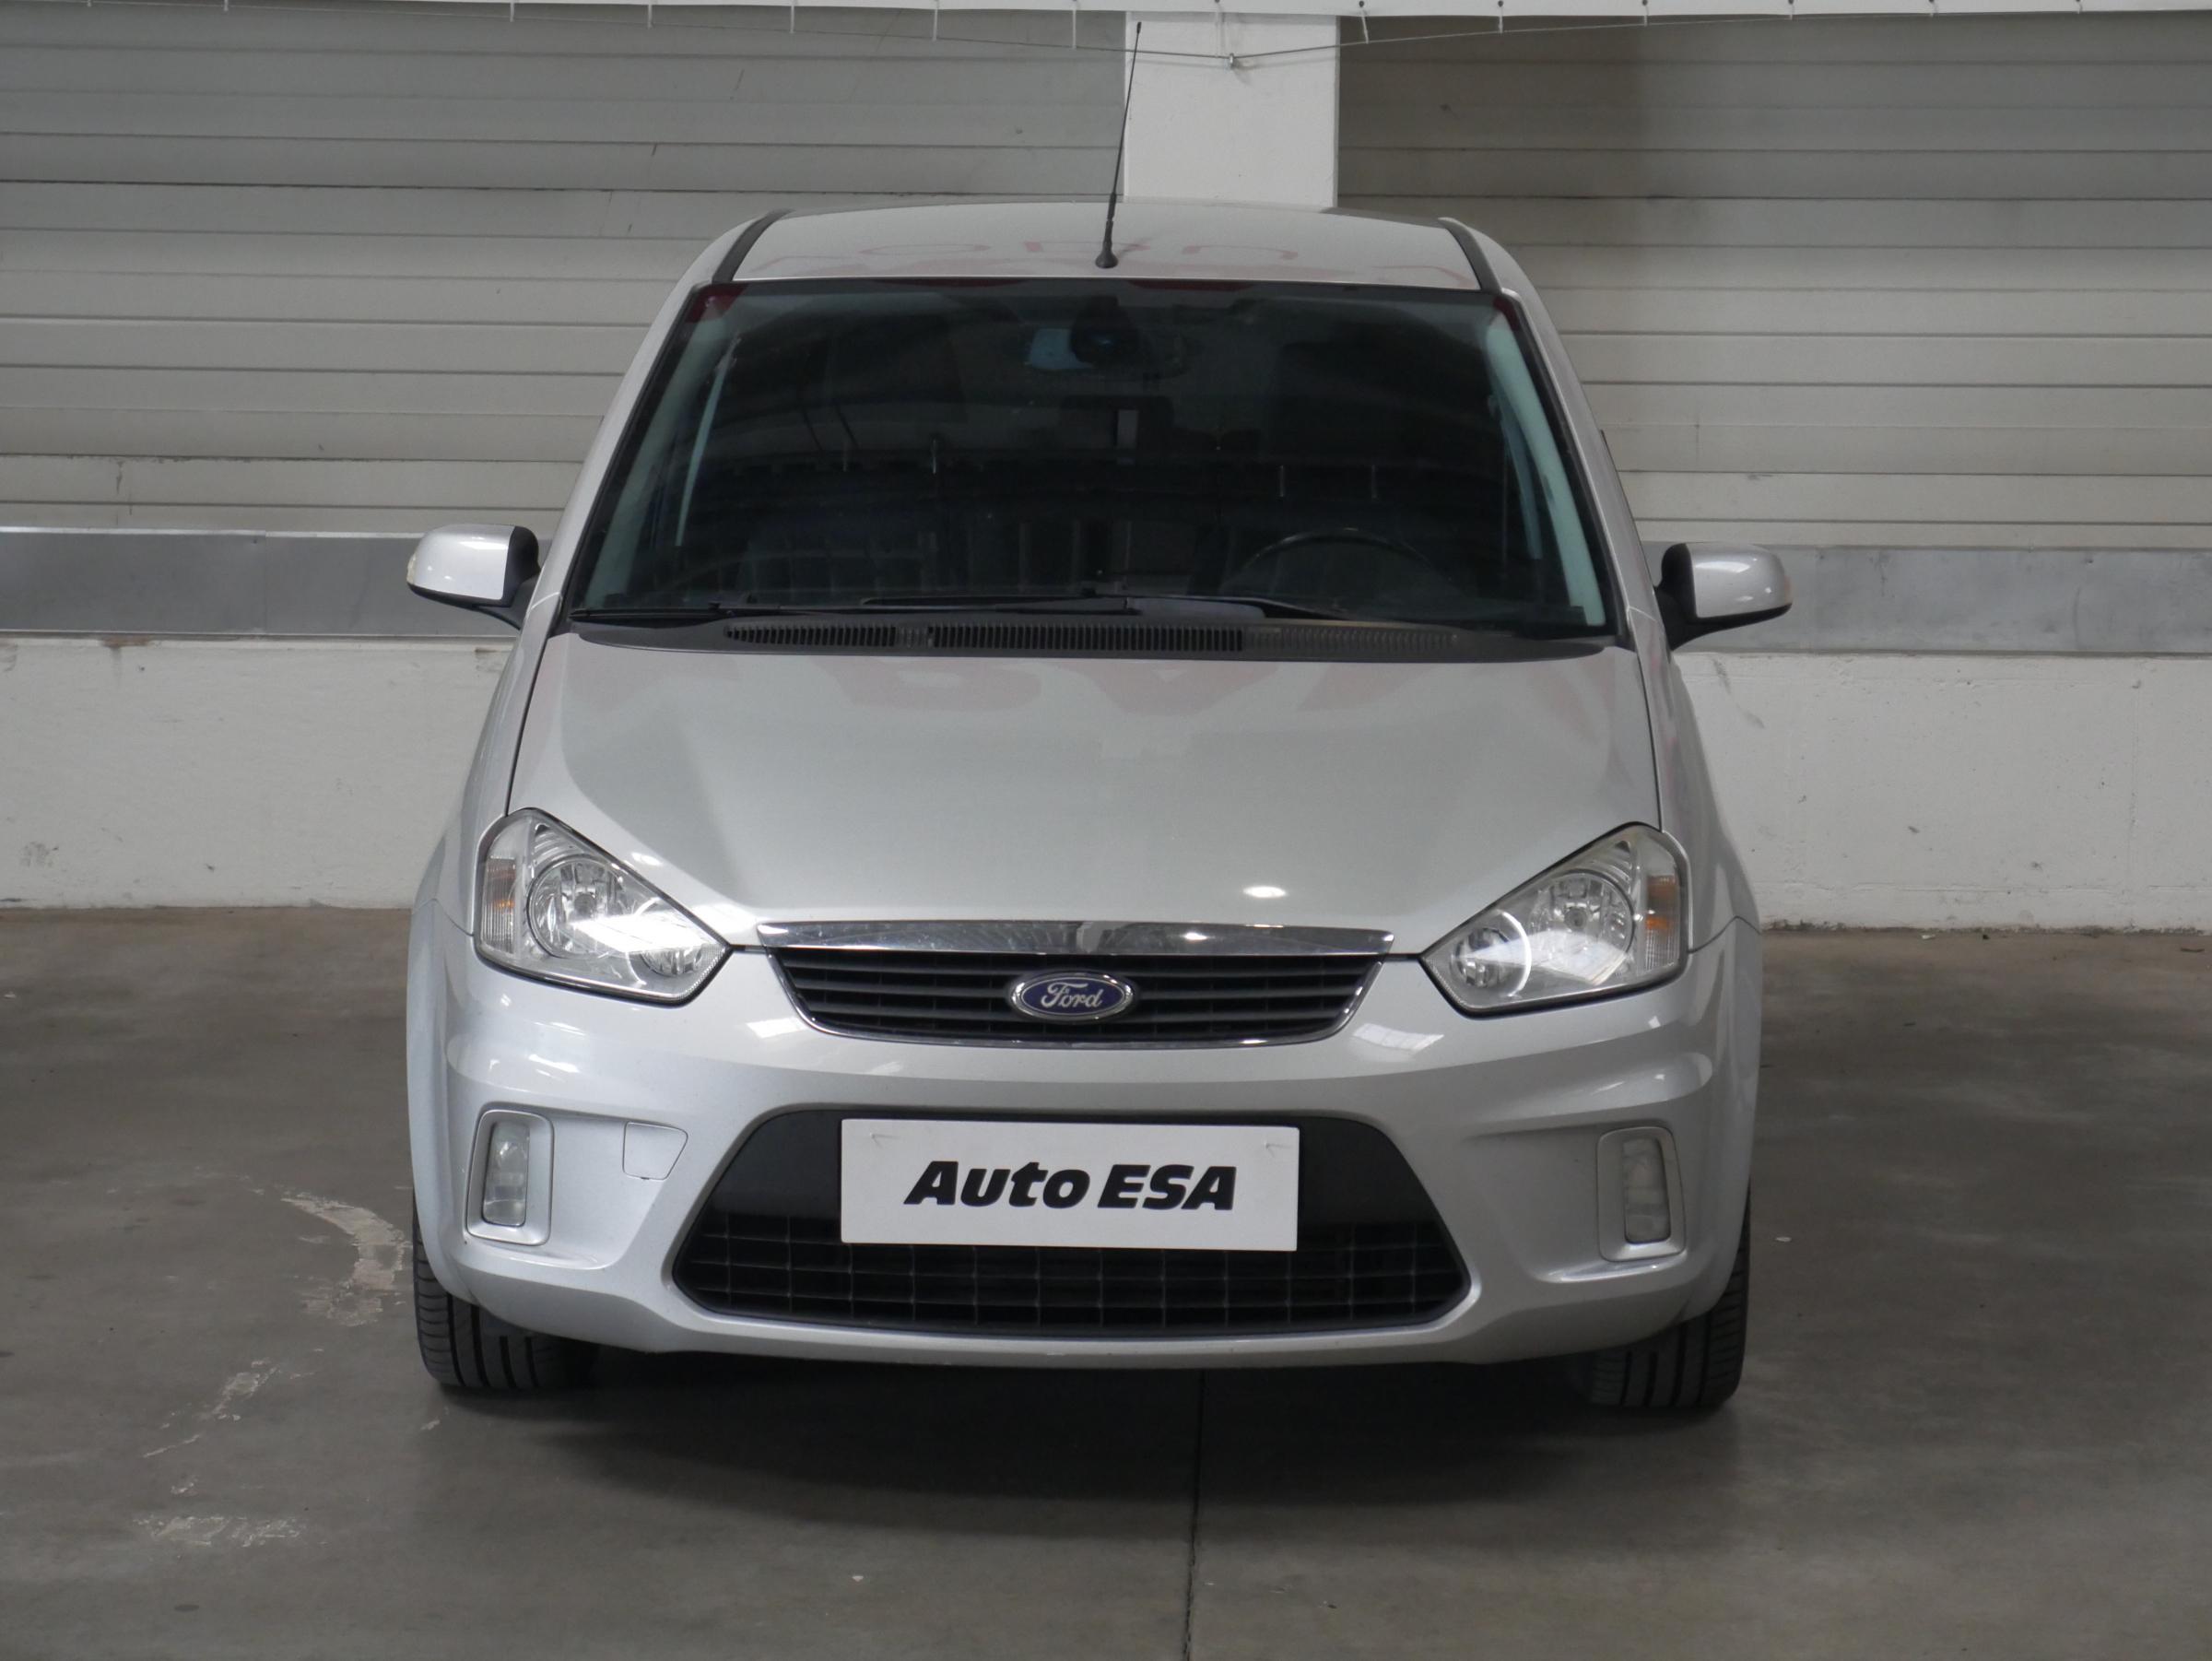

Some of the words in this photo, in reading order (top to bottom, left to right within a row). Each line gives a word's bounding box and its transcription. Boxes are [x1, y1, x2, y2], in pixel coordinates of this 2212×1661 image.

[1041, 982, 1104, 1008] Ford
[903, 1160, 1090, 1209] Auto
[1097, 1163, 1237, 1211] ESA
